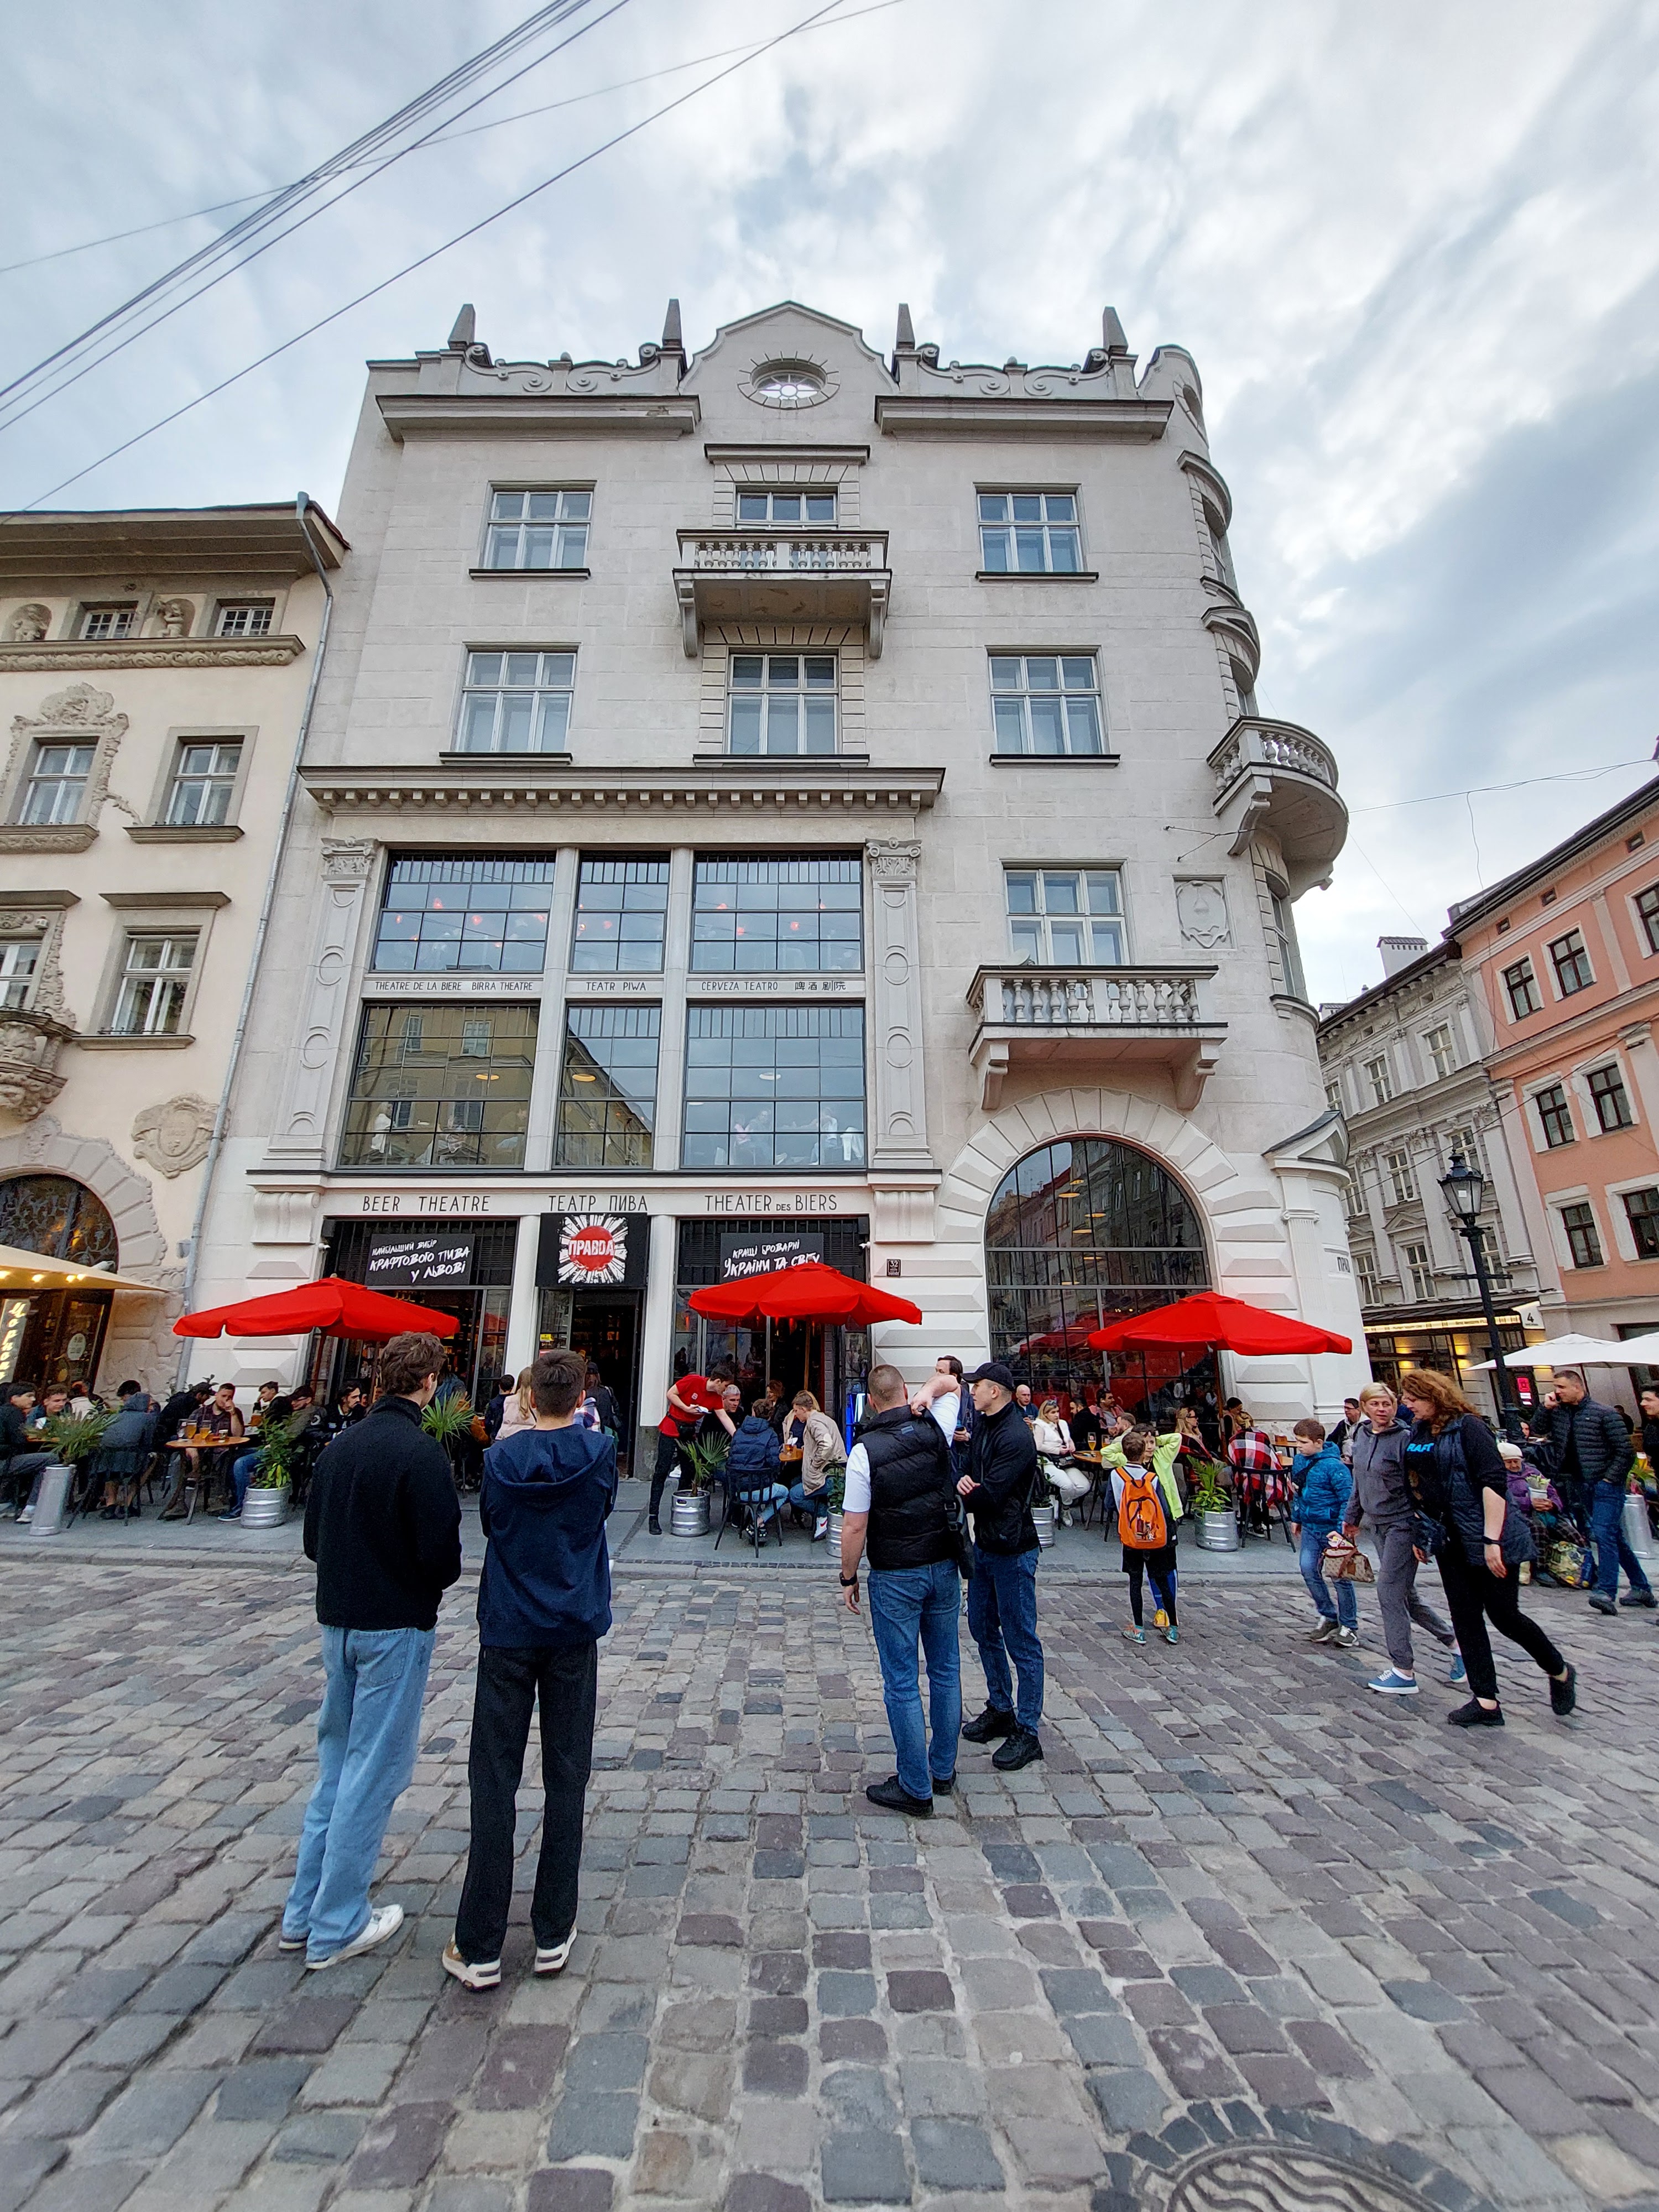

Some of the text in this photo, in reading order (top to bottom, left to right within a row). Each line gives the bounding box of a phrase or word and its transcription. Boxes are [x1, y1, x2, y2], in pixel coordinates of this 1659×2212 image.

[375, 981, 462, 991] THEATRE DE LA BIERE
[472, 982, 534, 991] BIRRA THEATRE
[586, 982, 646, 991] TEATR PIWA
[701, 982, 778, 991] CERVEZA TEATRO
[362, 1196, 491, 1212] BEER THEATRE
[549, 1195, 648, 1211] ТЕАТР ПИВА
[705, 1194, 771, 1212] THEATER
[795, 1194, 837, 1211] BIERS
[733, 1239, 800, 1259] КРАЩІ БРОВАРНІ
[369, 1246, 471, 1271] КРАФТОВОГО ПИВА
[723, 1258, 770, 1277] УКРАЇНИ
[774, 1256, 789, 1270] ТА
[411, 1260, 466, 1284] У ЛЬВОВІ
[1527, 1312, 1535, 1323] 4
